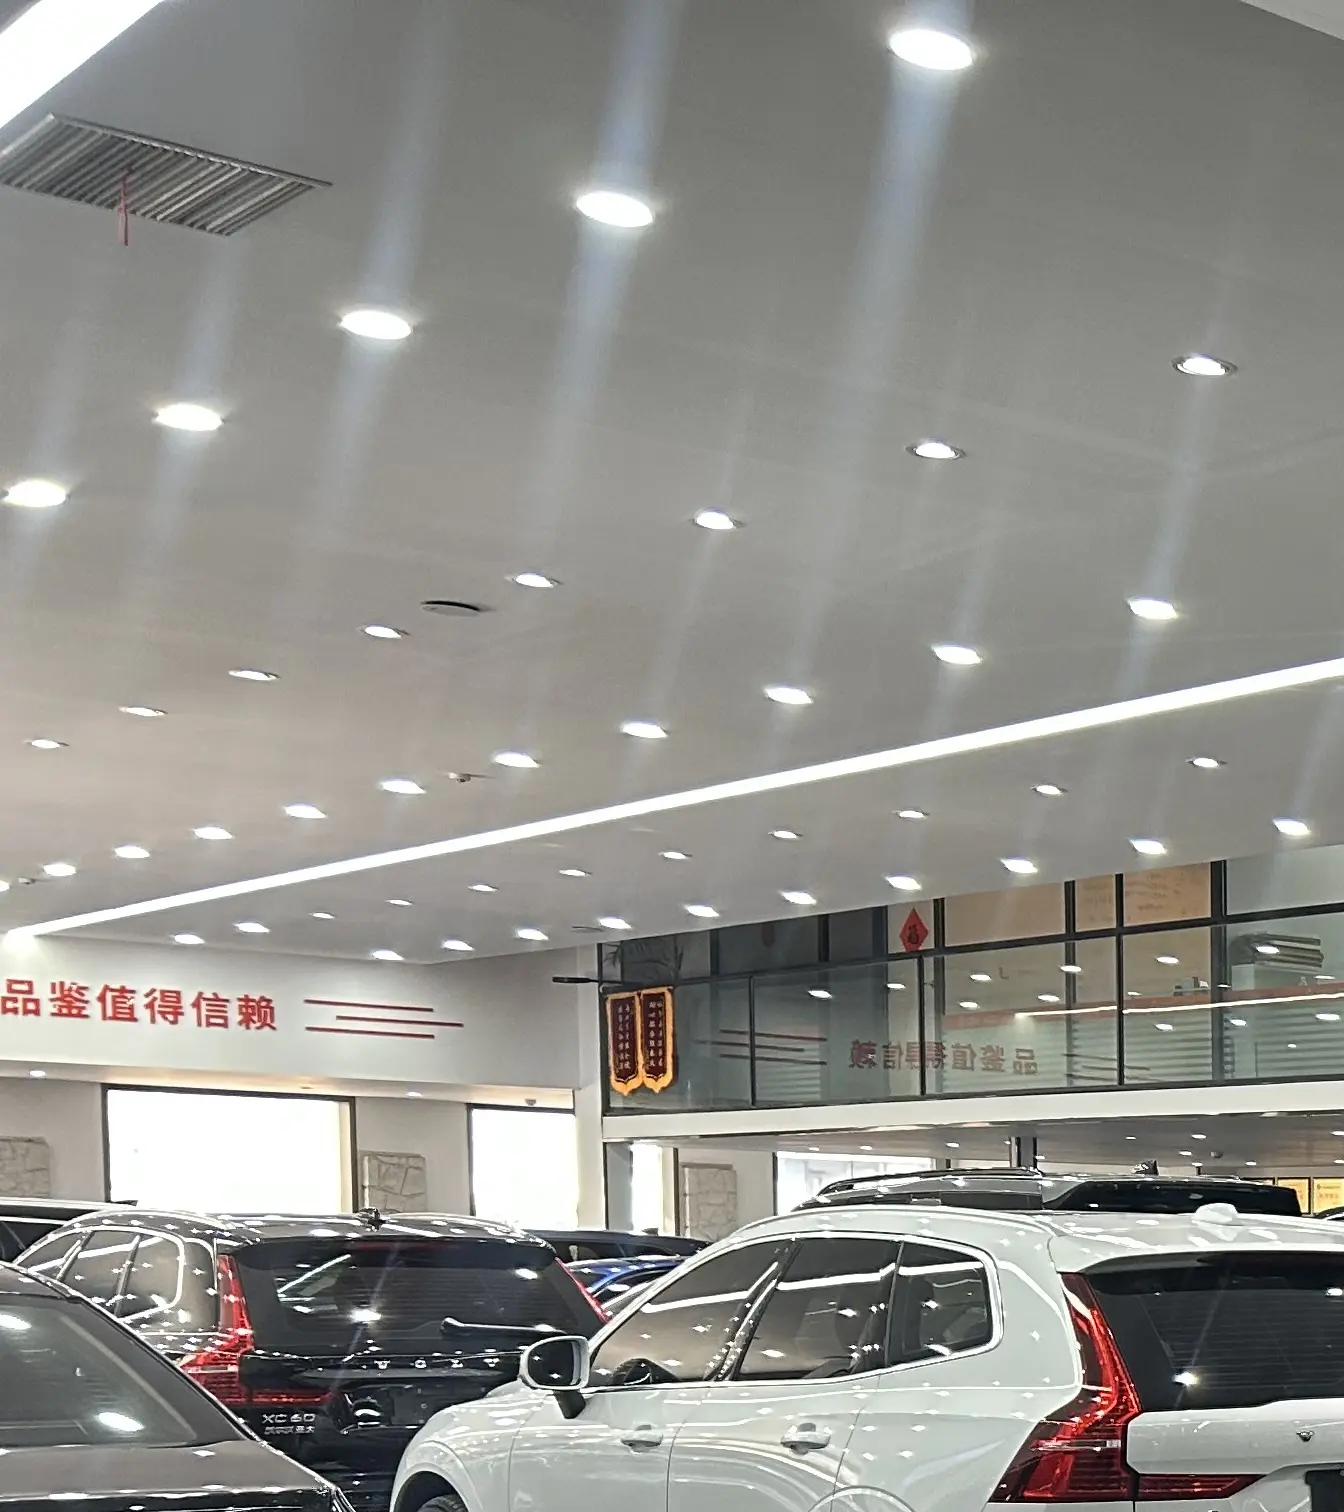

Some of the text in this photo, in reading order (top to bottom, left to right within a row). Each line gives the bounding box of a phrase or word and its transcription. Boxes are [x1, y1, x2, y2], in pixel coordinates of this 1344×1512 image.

[0, 978, 277, 1031] 品鉴值得信赖
